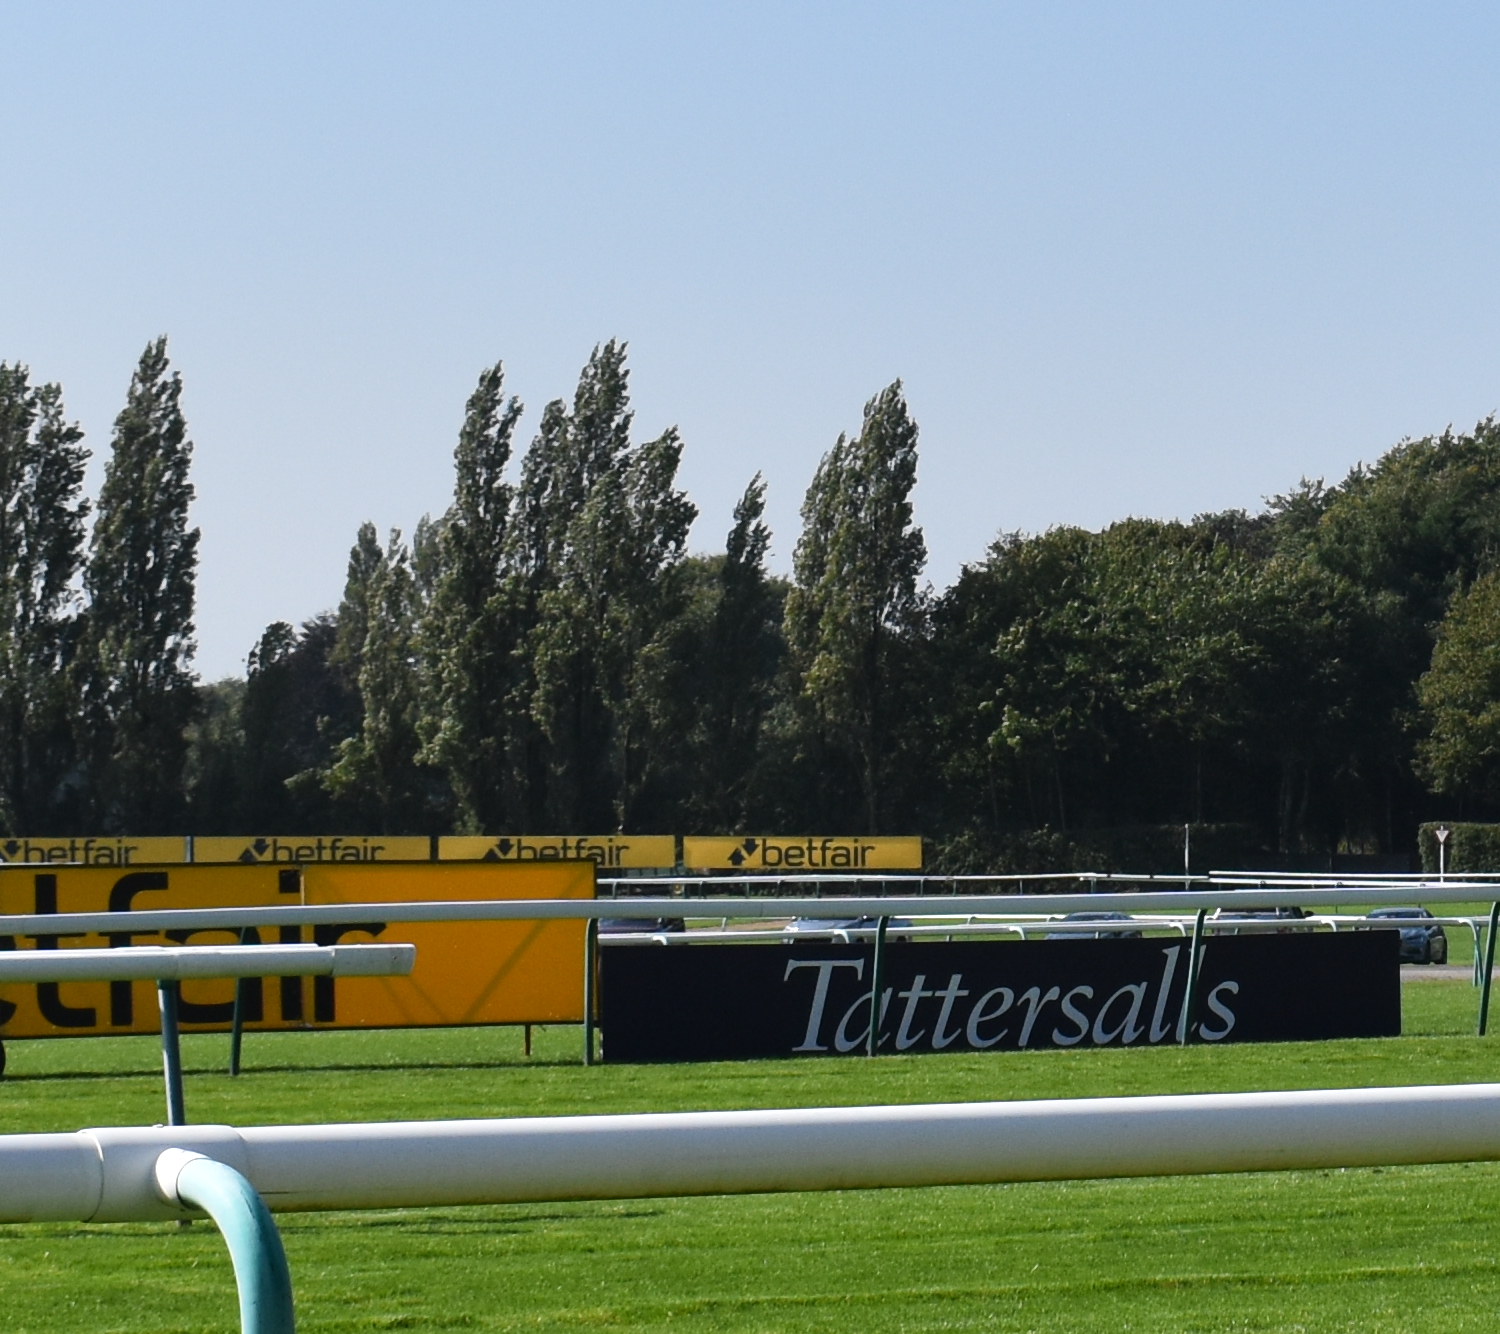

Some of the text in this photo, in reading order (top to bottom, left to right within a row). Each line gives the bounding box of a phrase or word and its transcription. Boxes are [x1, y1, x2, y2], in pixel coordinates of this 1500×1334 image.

[24, 839, 137, 863] betfair
[272, 838, 385, 860] betfair
[517, 838, 630, 866] betfair
[762, 838, 876, 867] betfair
[784, 945, 1239, 1053] Tattersalls
